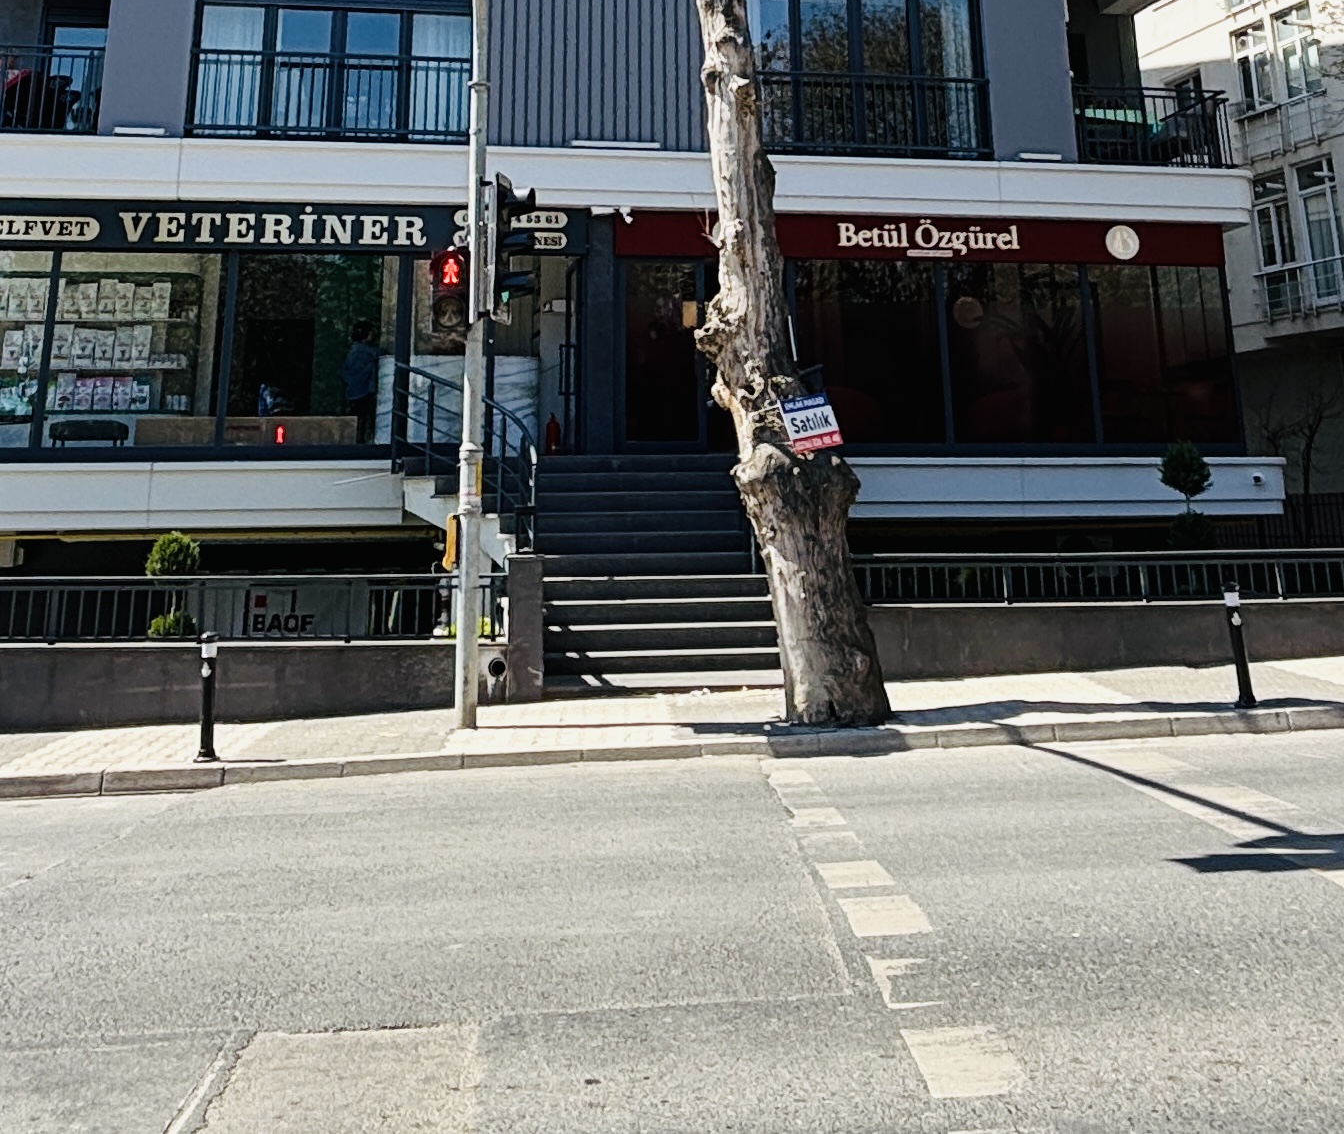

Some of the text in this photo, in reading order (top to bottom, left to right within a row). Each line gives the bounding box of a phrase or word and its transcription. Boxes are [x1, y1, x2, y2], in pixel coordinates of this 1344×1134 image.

[118, 206, 427, 246] VETERİNER
[837, 219, 1021, 256] Betül Özgürel
[790, 410, 833, 435] Satılık
[252, 613, 315, 633] BAOF
